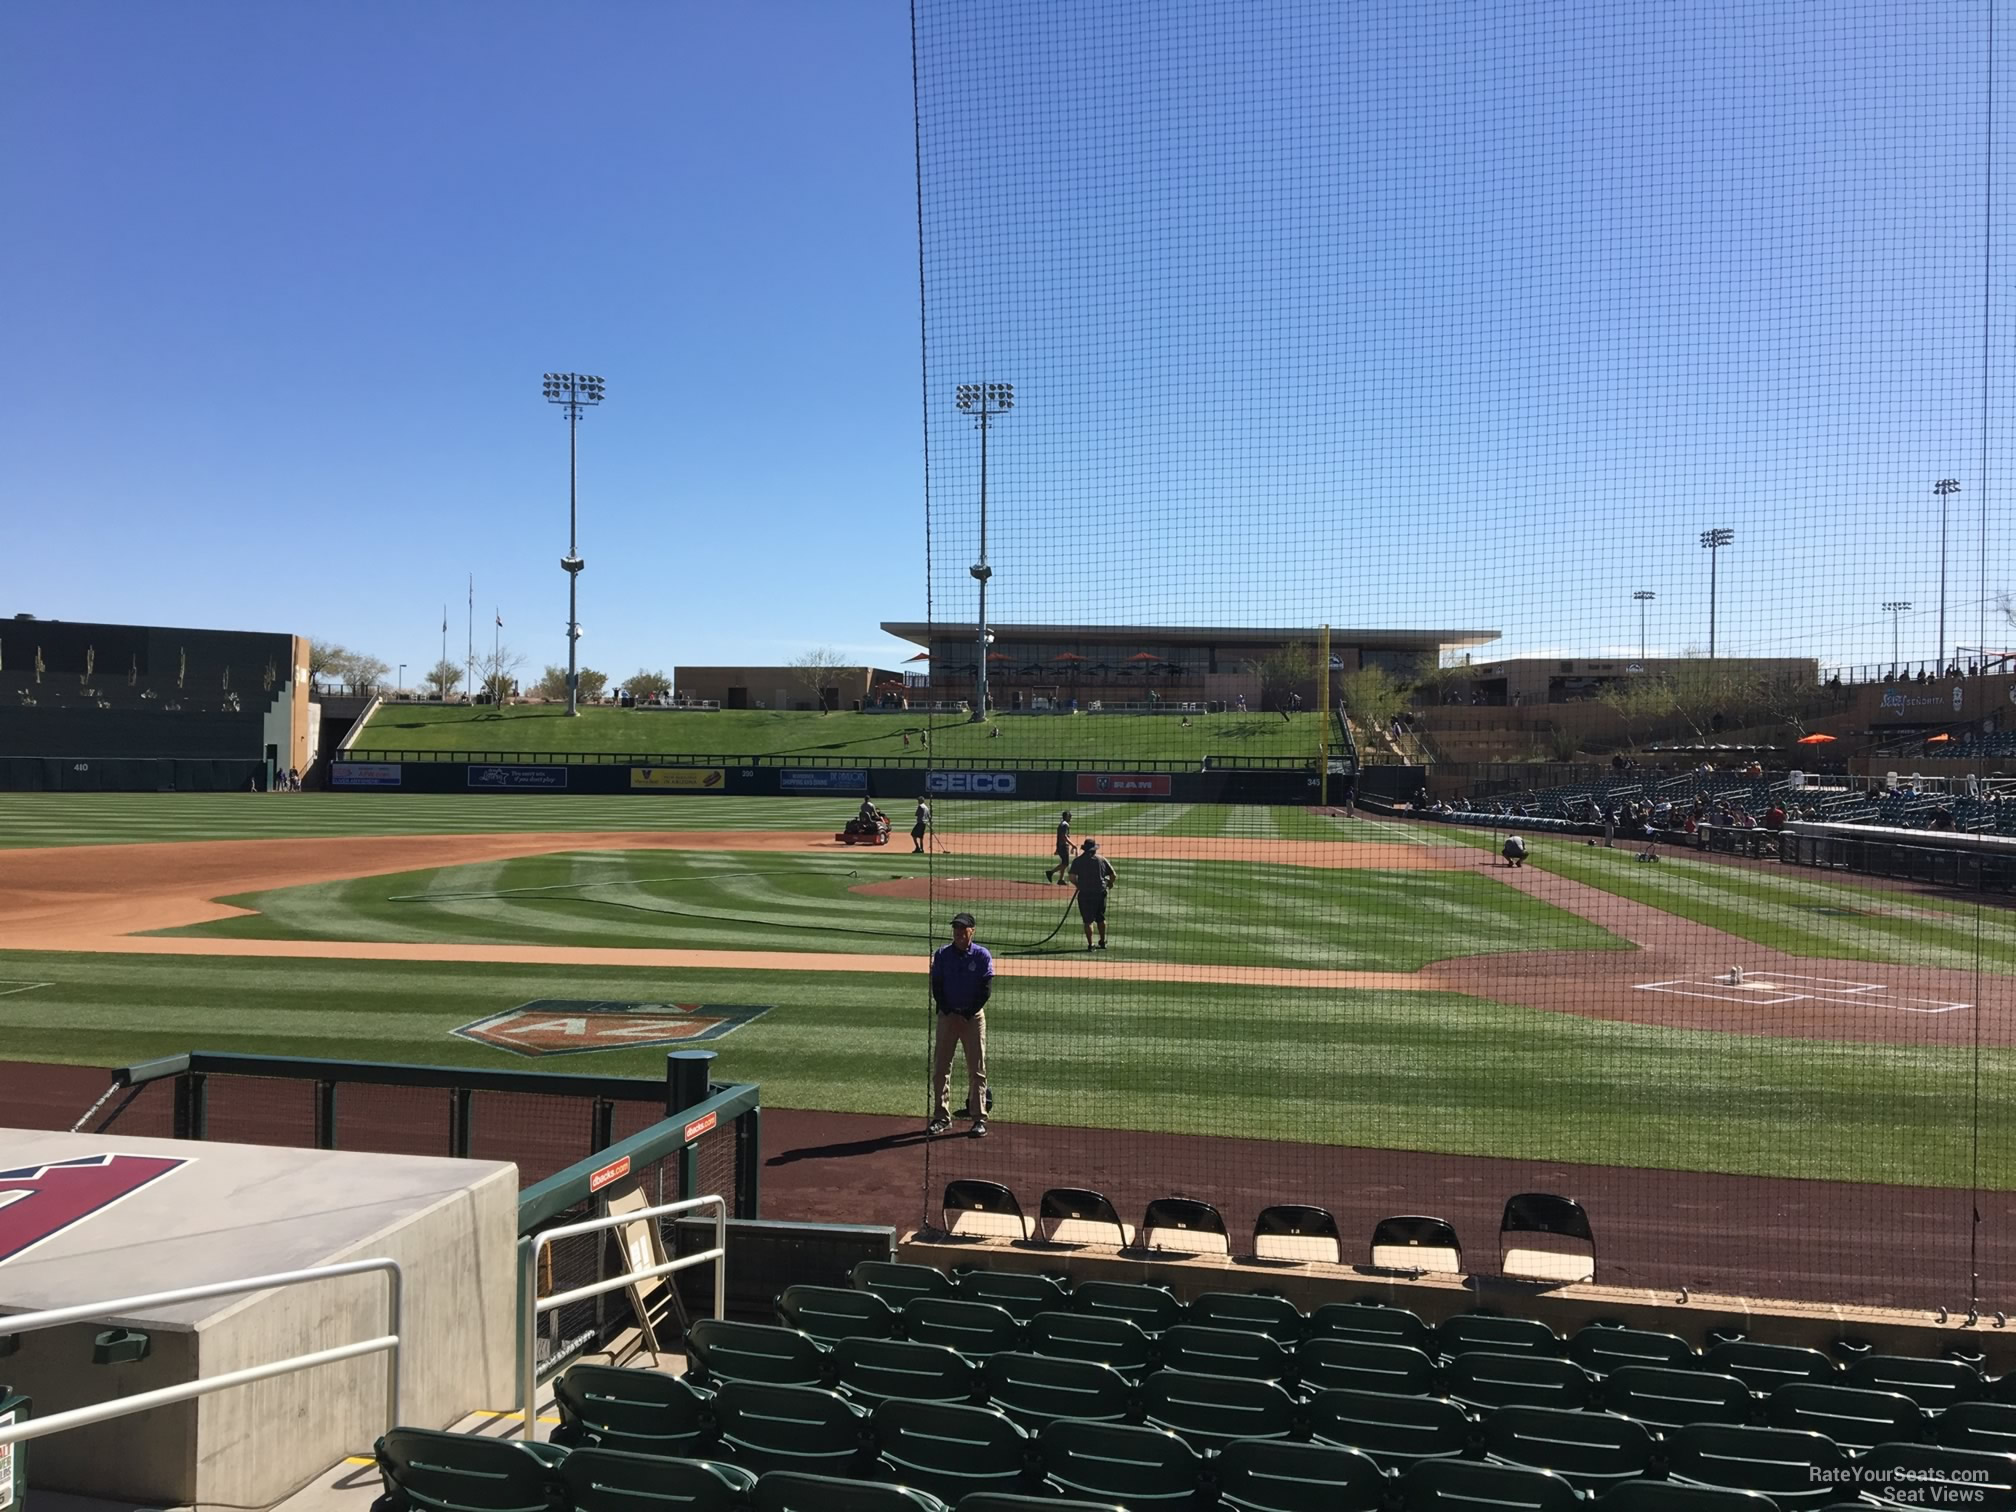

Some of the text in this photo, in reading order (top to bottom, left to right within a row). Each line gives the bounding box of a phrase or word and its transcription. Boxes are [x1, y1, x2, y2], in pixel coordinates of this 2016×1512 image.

[926, 773, 1016, 792] GEICO
[1113, 781, 1153, 789] RAM
[502, 1017, 693, 1037] AZ
[686, 1116, 715, 1138] dbacks.com
[592, 1162, 628, 1188] dbacks.com
